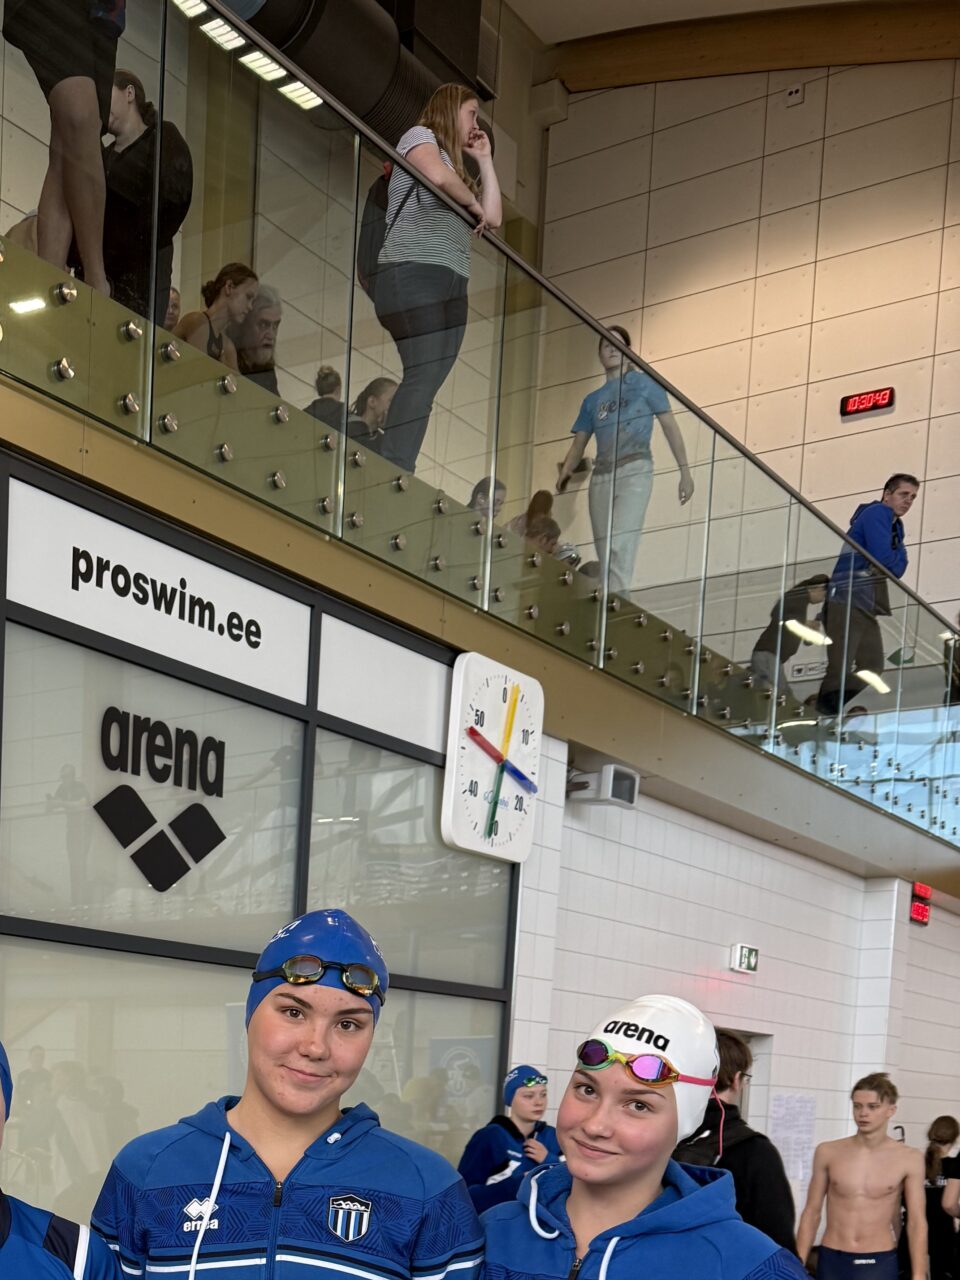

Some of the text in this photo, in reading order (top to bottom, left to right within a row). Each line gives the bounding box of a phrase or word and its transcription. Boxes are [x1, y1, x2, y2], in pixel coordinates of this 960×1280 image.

[71, 546, 262, 650] proswim.ee
[502, 686, 508, 704] 0
[474, 708, 485, 728] 50
[521, 728, 530, 746] 10
[100, 706, 226, 799] arena
[468, 779, 479, 798] 40
[514, 796, 525, 812] 20
[603, 1020, 671, 1052] arena
